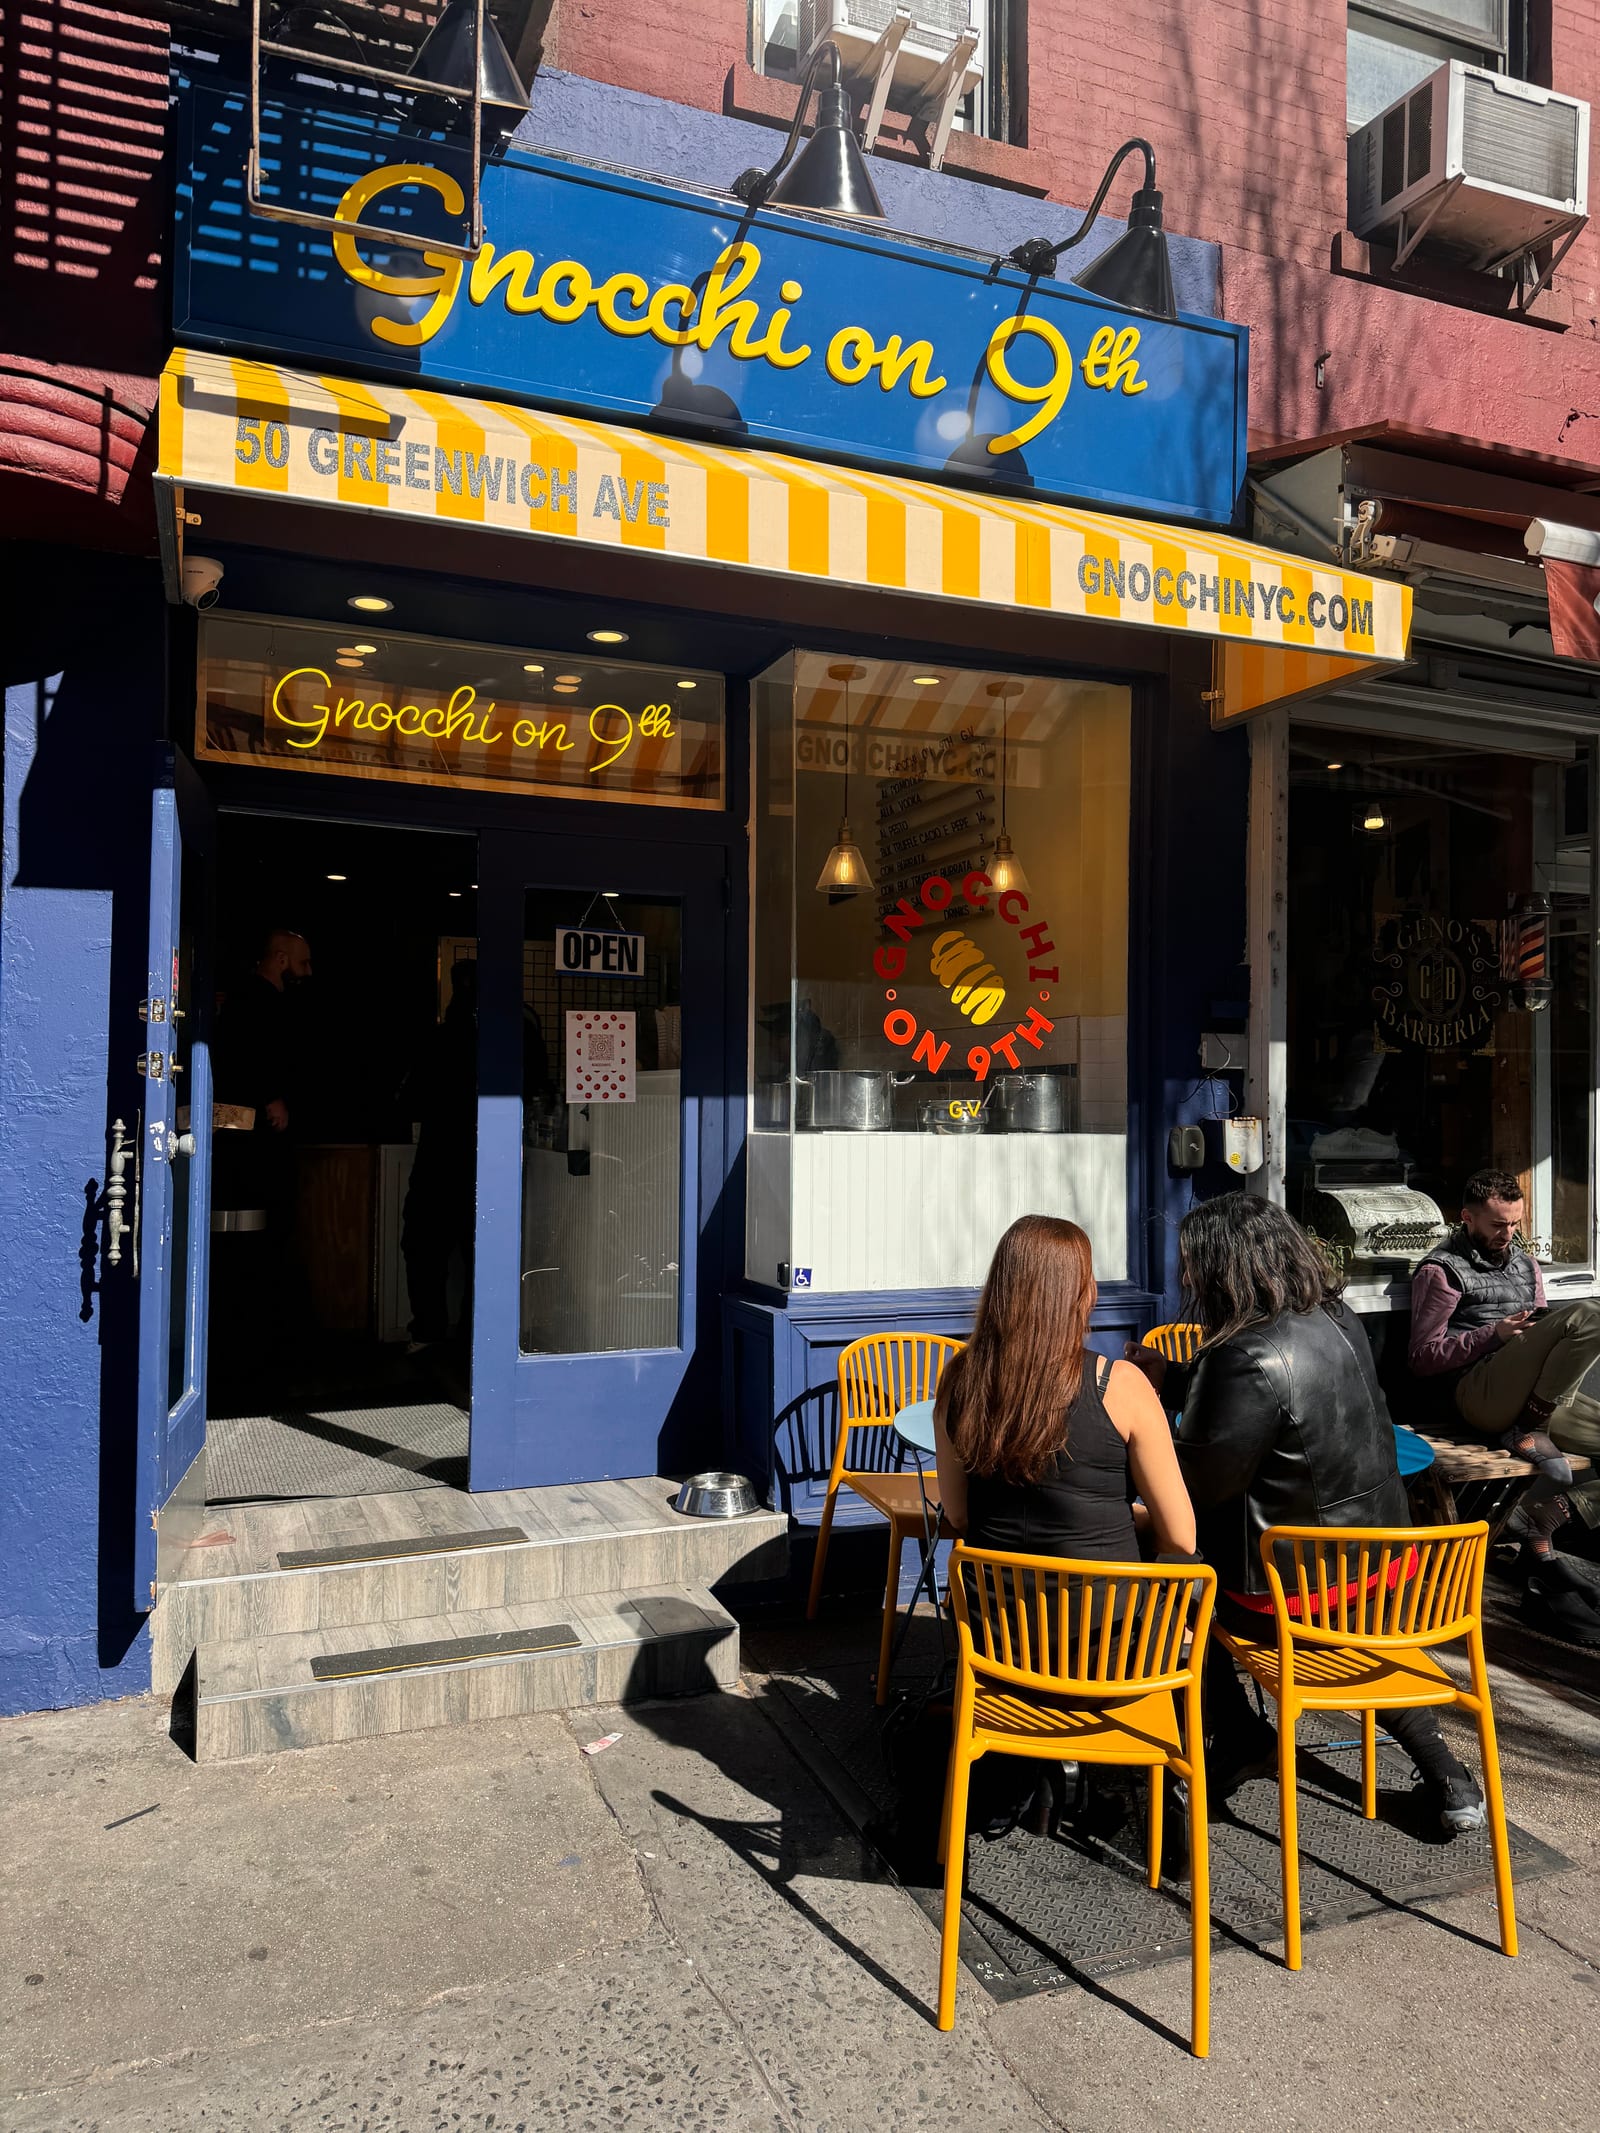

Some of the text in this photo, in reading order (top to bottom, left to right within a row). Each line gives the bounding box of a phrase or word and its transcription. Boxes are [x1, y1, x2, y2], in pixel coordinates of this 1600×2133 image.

[333, 163, 1148, 455] Gnocchi on 9th
[235, 416, 671, 528] 50 GREENWICH AVE
[1077, 554, 1374, 636] GNOCCHINYC.COM
[272, 668, 676, 773] Gnocchi on 9th
[888, 820, 908, 835] PESTO
[918, 827, 942, 844] CACIO
[943, 823, 950, 836] E
[950, 816, 969, 833] PEPE
[978, 832, 985, 845] 3
[980, 855, 986, 867] 5
[873, 871, 1059, 983] GNOCCHI
[1397, 916, 1481, 957] GENO'S
[562, 931, 638, 973] OPEN
[884, 1006, 1055, 1082] ON 9TH
[1380, 998, 1491, 1047] BARBERIA
